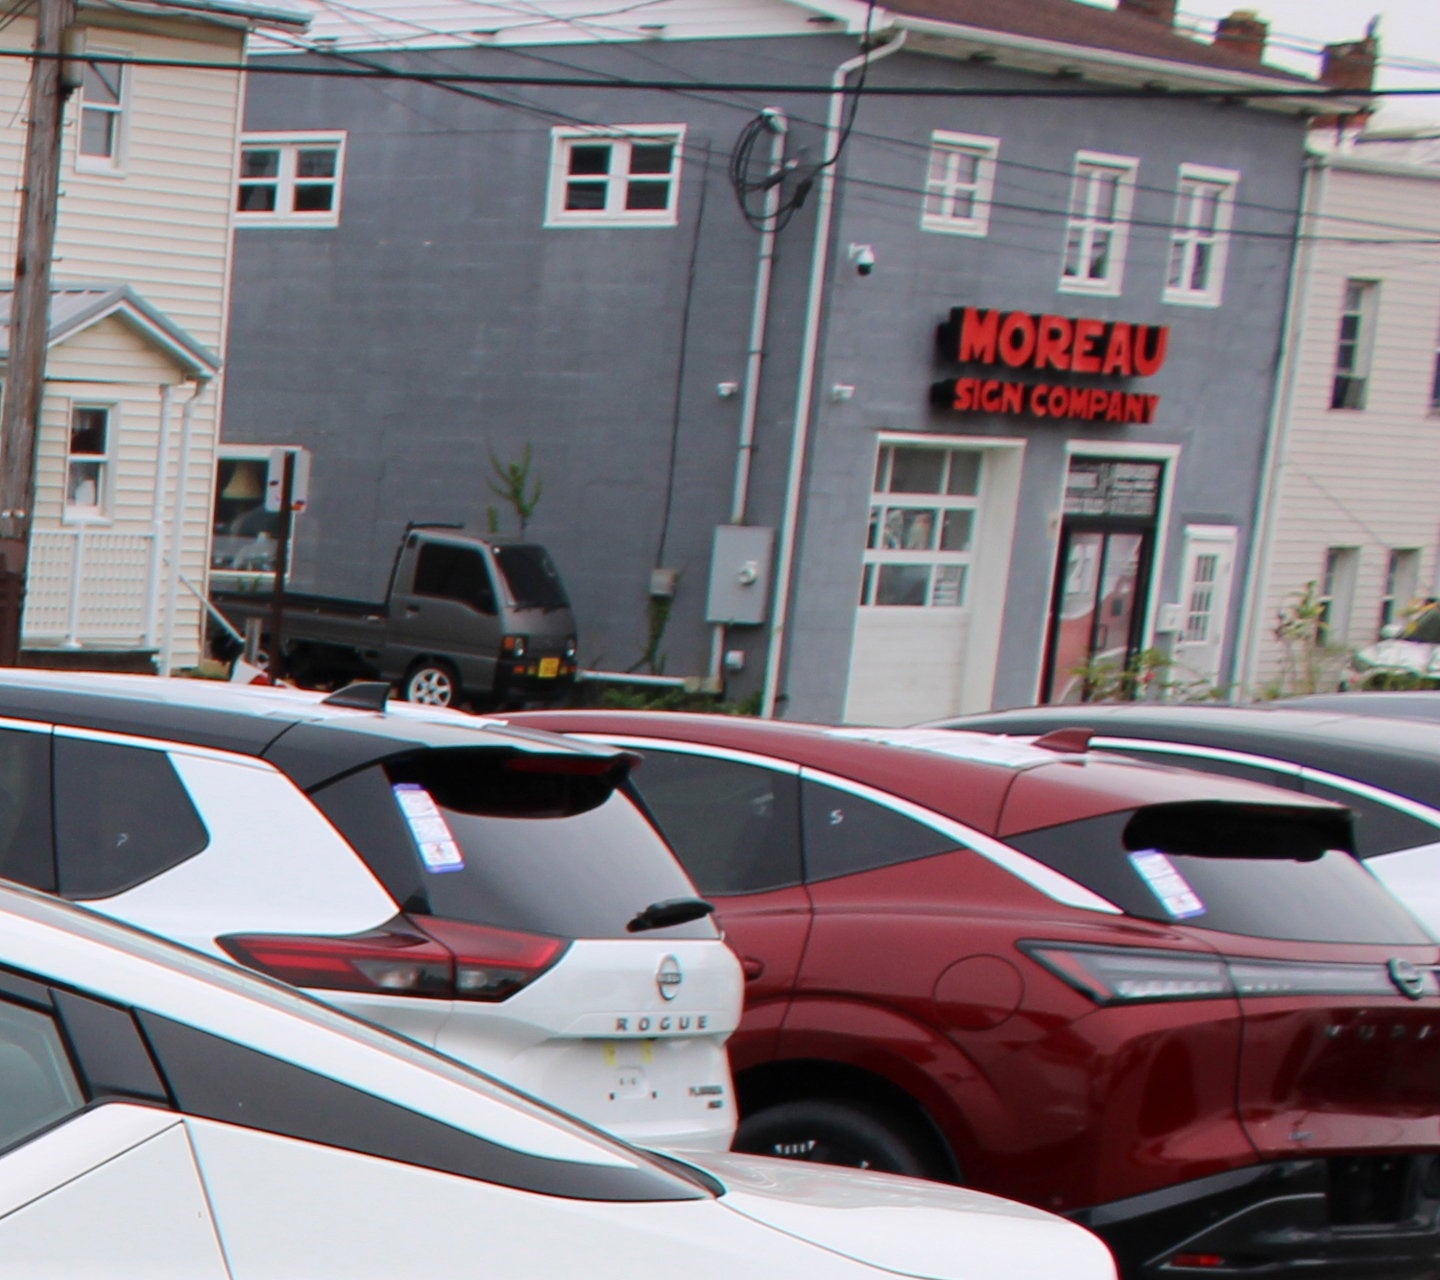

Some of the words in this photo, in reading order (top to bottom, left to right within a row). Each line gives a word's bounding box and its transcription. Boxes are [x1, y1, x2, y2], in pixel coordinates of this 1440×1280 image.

[958, 306, 1170, 377] MOREAU
[952, 377, 1025, 414] SIGN
[1030, 384, 1161, 424] COMPANY
[615, 1015, 708, 1032] ROGUE
